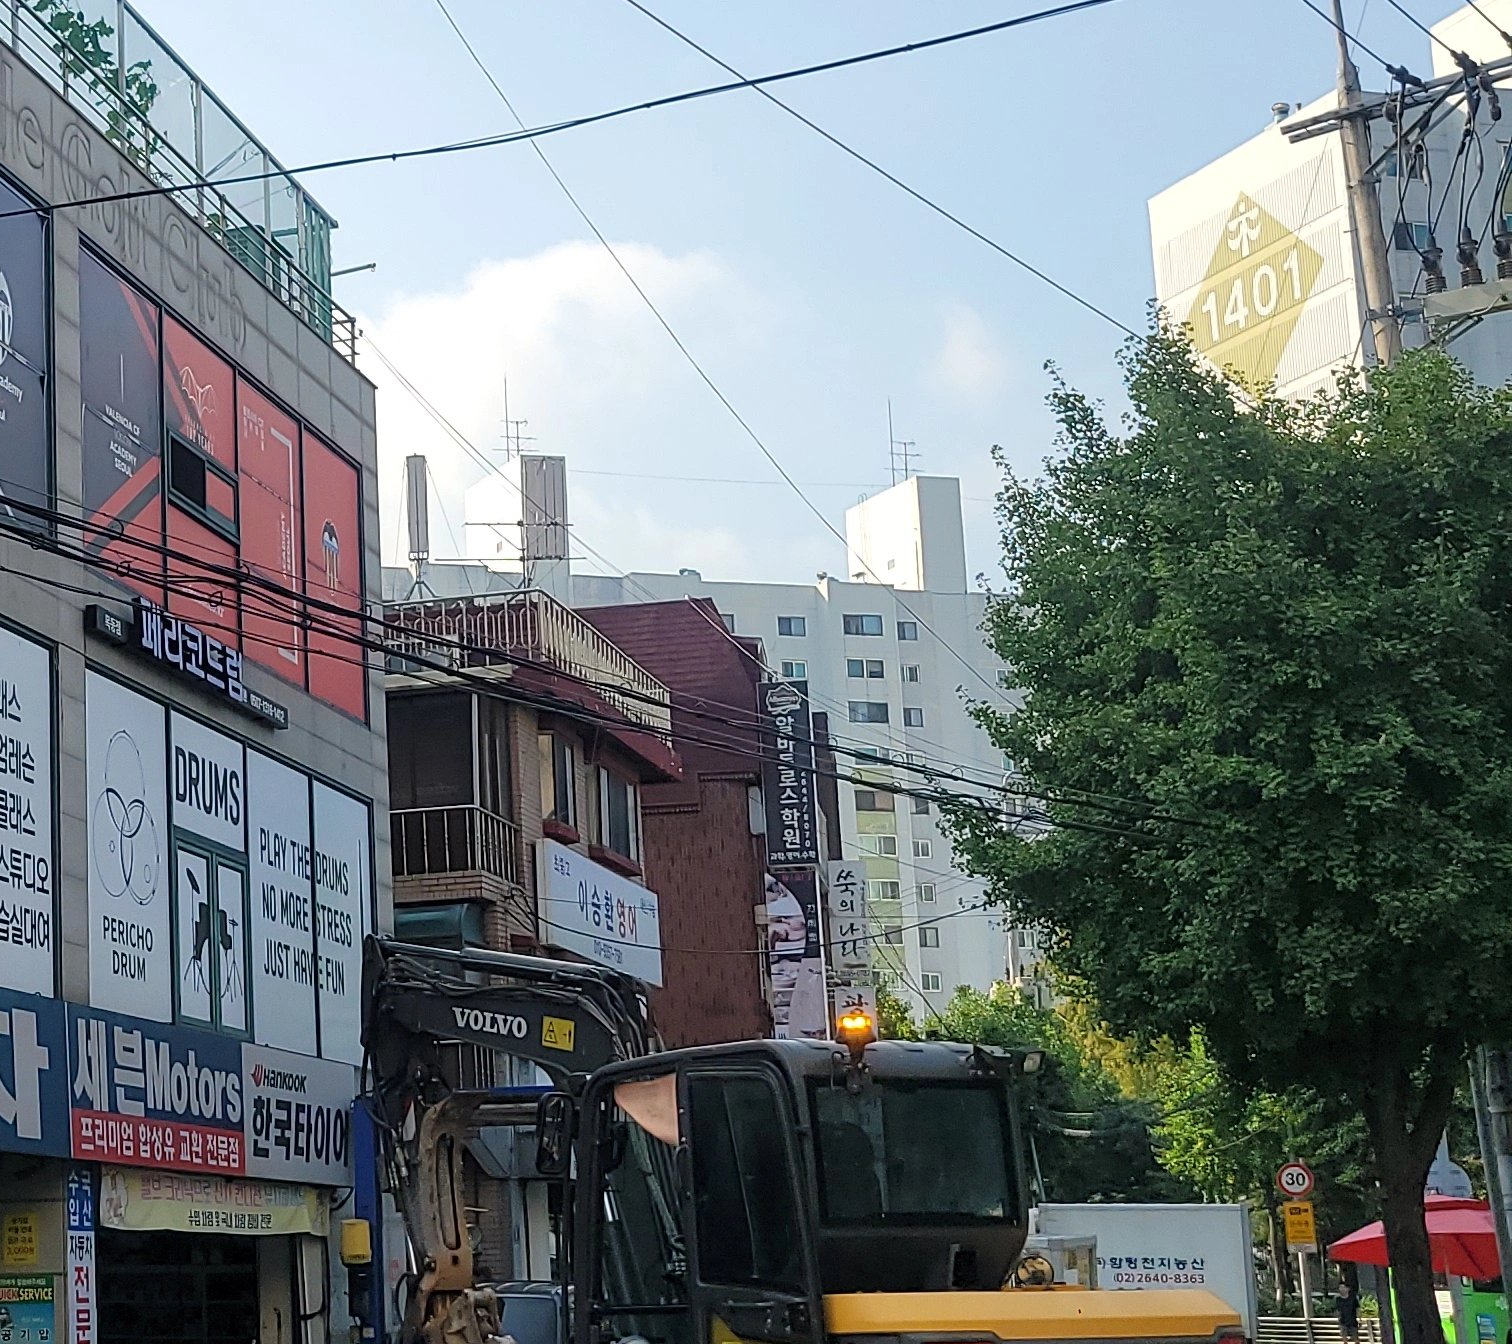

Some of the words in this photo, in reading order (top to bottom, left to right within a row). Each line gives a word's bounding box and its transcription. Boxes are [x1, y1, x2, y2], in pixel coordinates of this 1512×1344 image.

[1200, 248, 1303, 344] 1401
[174, 745, 240, 826] DRUMS
[259, 826, 286, 872] PLAY
[289, 839, 311, 882] THE
[314, 849, 349, 897] DRUMS
[102, 914, 153, 953] PERICHO
[261, 881, 277, 923] NO
[279, 901, 309, 934] MORE
[315, 903, 353, 949] STRESS
[112, 949, 146, 982] DRUM
[263, 938, 291, 981] JUST
[293, 952, 324, 990] HAVE
[325, 955, 345, 997] FUN
[452, 1006, 528, 1039] VOLVO
[81, 1116, 134, 1157] 프리미엄
[138, 1123, 176, 1162] 합성유
[179, 1128, 203, 1164] 교환
[206, 1133, 240, 1169] 전문점
[252, 1094, 350, 1168] 한국타이어
[1285, 1172, 1306, 1187] 30
[19, 1287, 54, 1302] SERVICE
